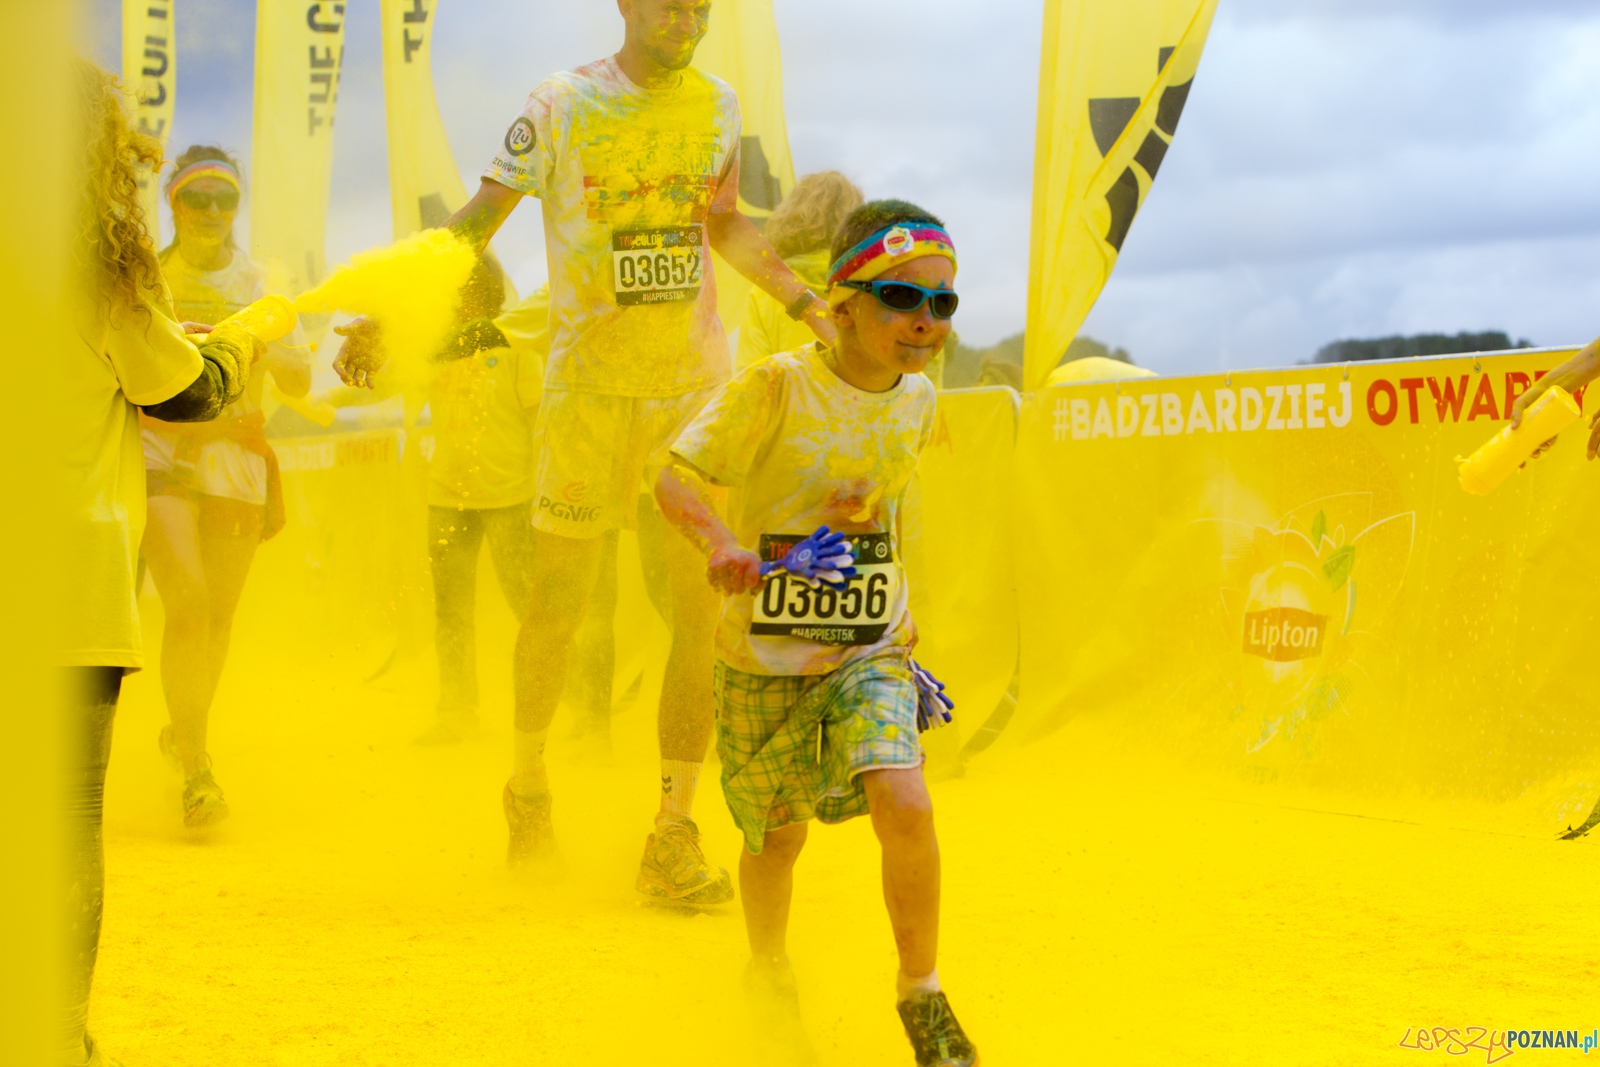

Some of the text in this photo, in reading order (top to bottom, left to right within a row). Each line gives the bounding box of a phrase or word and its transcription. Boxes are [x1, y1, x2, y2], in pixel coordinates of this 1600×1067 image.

[619, 252, 700, 289] 03652
[761, 571, 889, 620] 03656
[790, 626, 856, 642] #HAPPIEST5K
[1249, 617, 1319, 654] Lipton
